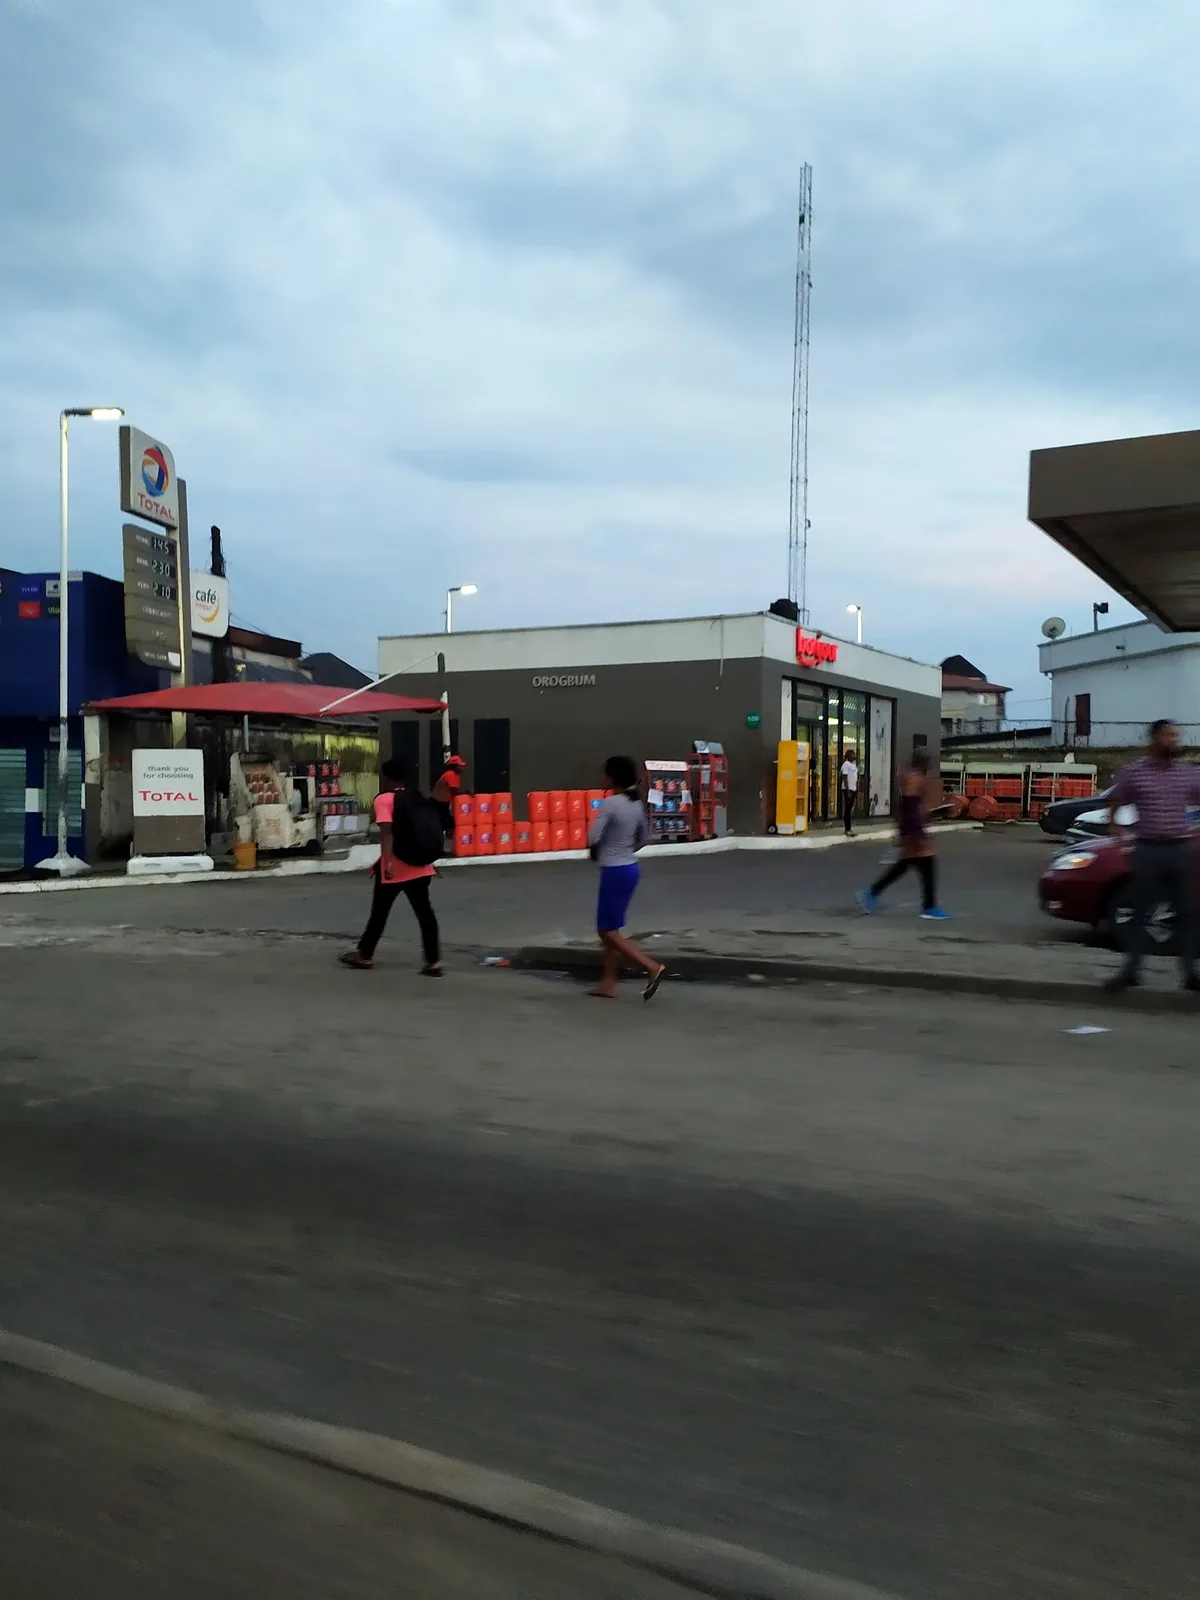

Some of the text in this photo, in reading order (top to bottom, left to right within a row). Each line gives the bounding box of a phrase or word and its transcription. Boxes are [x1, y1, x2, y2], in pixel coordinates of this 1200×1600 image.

[137, 491, 175, 521] TOTAL
[153, 537, 170, 555] 145
[152, 558, 171, 578] 230
[195, 588, 217, 605] café
[532, 674, 597, 688] OROGBUM
[138, 790, 199, 802] TOTAL
